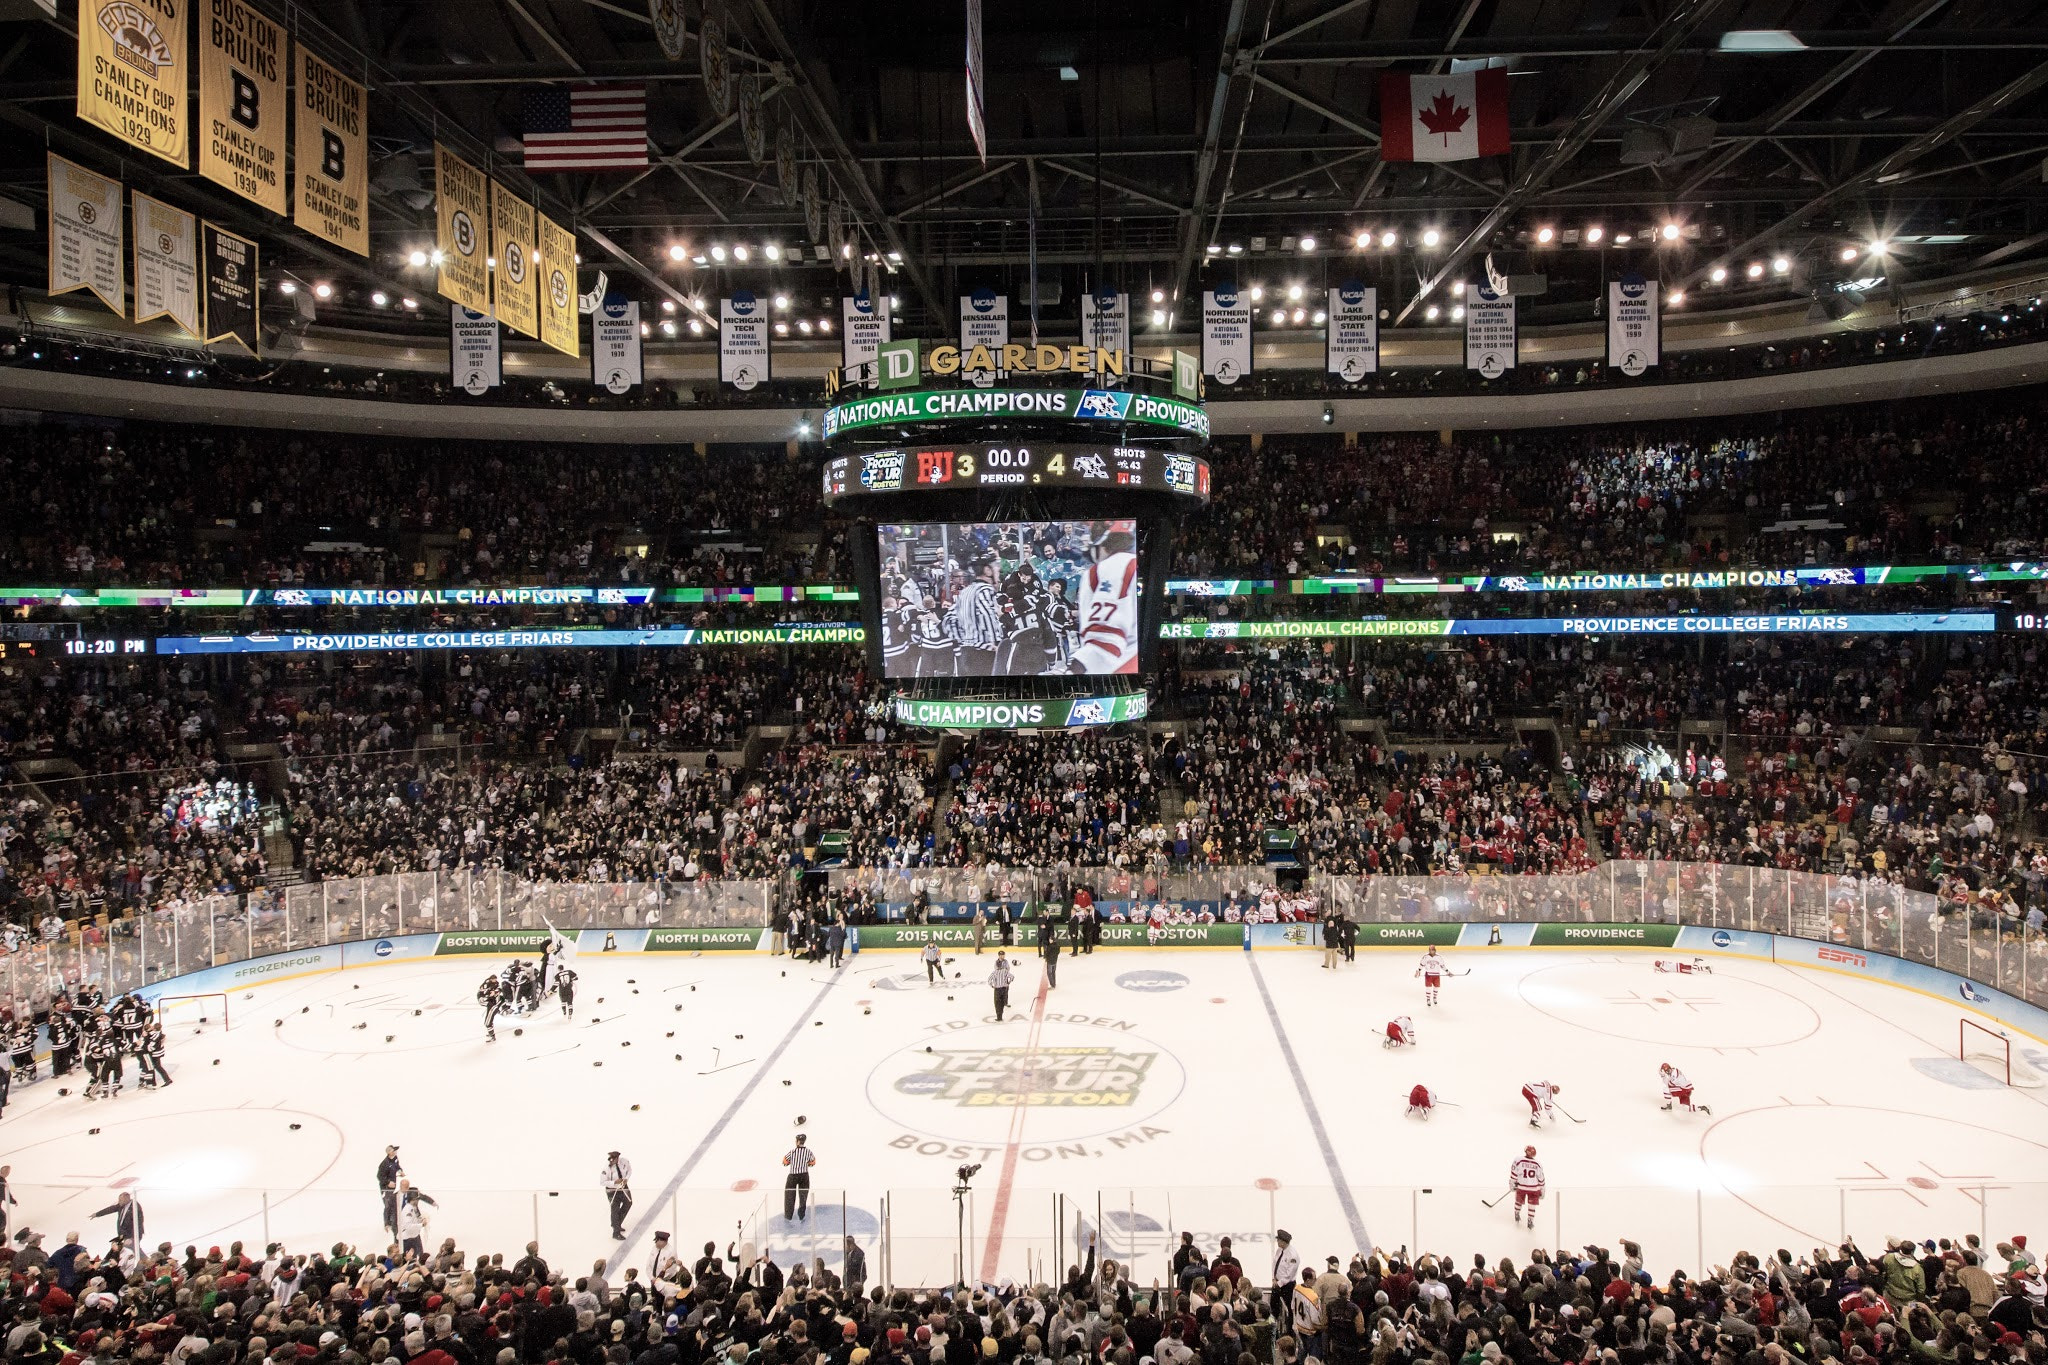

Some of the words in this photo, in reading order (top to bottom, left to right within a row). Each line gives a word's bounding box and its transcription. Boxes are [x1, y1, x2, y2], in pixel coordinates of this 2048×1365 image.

[101, 5, 171, 62] BOSTON
[212, 0, 277, 54] BOSTON
[117, 45, 155, 75] BRUINS
[212, 18, 277, 83] BRUINS
[95, 55, 149, 100] STANLEY
[152, 88, 175, 112] CUP
[305, 54, 359, 110] BOSTON
[94, 78, 176, 135] CHAMPIONS
[230, 65, 261, 132] B
[305, 82, 359, 137] BRUINS
[121, 116, 151, 145] 1929
[212, 119, 256, 154] STANLEY
[258, 146, 275, 166] CUP
[212, 139, 276, 187] CHAMPIONS
[321, 125, 345, 183] B
[442, 151, 481, 192] BOSTON
[233, 171, 257, 197] 1939
[305, 174, 342, 205] STANLEY
[343, 194, 358, 212] CUP
[443, 175, 482, 217] BRUINS
[497, 188, 530, 223] BOSTON
[304, 192, 360, 232] CHAMPIONS
[323, 220, 343, 241] 1941
[457, 216, 471, 246] B
[497, 211, 531, 246] BRUINS
[544, 219, 572, 249] BOSTON
[544, 239, 573, 273] BRUINS
[1216, 294, 1239, 302] NCAA
[1341, 291, 1366, 299] NCAA
[1622, 284, 1646, 292] NCAA
[605, 304, 628, 313] NCAA
[732, 301, 757, 310] NCAA
[973, 298, 997, 307] NCAA
[1469, 302, 1513, 310] MICHIGAN
[454, 321, 497, 330] COLORADO
[962, 314, 1006, 322] RENSSELAER
[1205, 317, 1248, 325] MICHIGAN
[459, 329, 492, 337] COLLEGE
[881, 349, 915, 379] TD
[929, 344, 1123, 376] GARDEN
[839, 397, 920, 426] NATIONAL
[925, 393, 1066, 413] CHAMPIONS
[1135, 399, 1208, 432] PROVIDENCE
[866, 456, 903, 470] FROZEN
[988, 448, 1030, 467] 00.0
[1113, 448, 1146, 459] SHOTS
[917, 451, 954, 483] BU
[957, 455, 975, 477] 3
[1047, 453, 1065, 476] 4
[1129, 461, 1141, 470] 43
[1171, 458, 1195, 472] FROZEN
[872, 479, 900, 489] BOSTON
[981, 473, 1025, 483] PERIOD
[1032, 474, 1040, 483] 3
[1130, 475, 1142, 484] 52
[1543, 574, 1652, 590] NATIONAL
[1660, 570, 1797, 588] CHAMPIONS
[331, 589, 448, 604] NATIONAL
[454, 588, 583, 604] CHAMPIONS
[1088, 602, 1118, 622] 27
[1159, 624, 1192, 638] ARS
[1250, 622, 1335, 636] NATIONAL
[1340, 621, 1439, 635] CHAMPIONS
[1563, 618, 1678, 632] PROVIDENCE
[1683, 615, 1771, 631] COLLEGE
[1776, 616, 1848, 631] FRIARS
[293, 634, 418, 650] PROVIDENCE
[423, 632, 505, 647] COLLEGE
[513, 631, 574, 645] FRIARS
[702, 629, 785, 643] NATIONAL
[788, 628, 865, 642] CHAMPIO
[65, 640, 115, 654] 10:20
[124, 640, 145, 653] PM
[919, 704, 1044, 724] CHAMPIONS
[446, 936, 498, 948] BOSTON
[655, 933, 699, 943] NORTH
[701, 933, 751, 943] DAKOTA
[896, 930, 929, 941] 2015
[932, 930, 975, 941] NCAA
[1101, 929, 1132, 940] OUR
[1379, 928, 1425, 938] OMAHA
[1564, 927, 1645, 939] PROVIDENCE
[234, 955, 321, 978] #FROZENFOUR
[1817, 947, 1867, 967] ESPN
[1122, 979, 1189, 988] NCAA
[924, 1020, 970, 1033] TD
[982, 1012, 1138, 1031] GARDEN
[948, 1053, 1148, 1072] FROZEN
[903, 1081, 945, 1089] NCAA
[966, 1092, 1132, 1106] BOSTON
[888, 1134, 1104, 1161] BOSTON,
[1105, 1123, 1171, 1149] MA
[1523, 1169, 1536, 1179] 10
